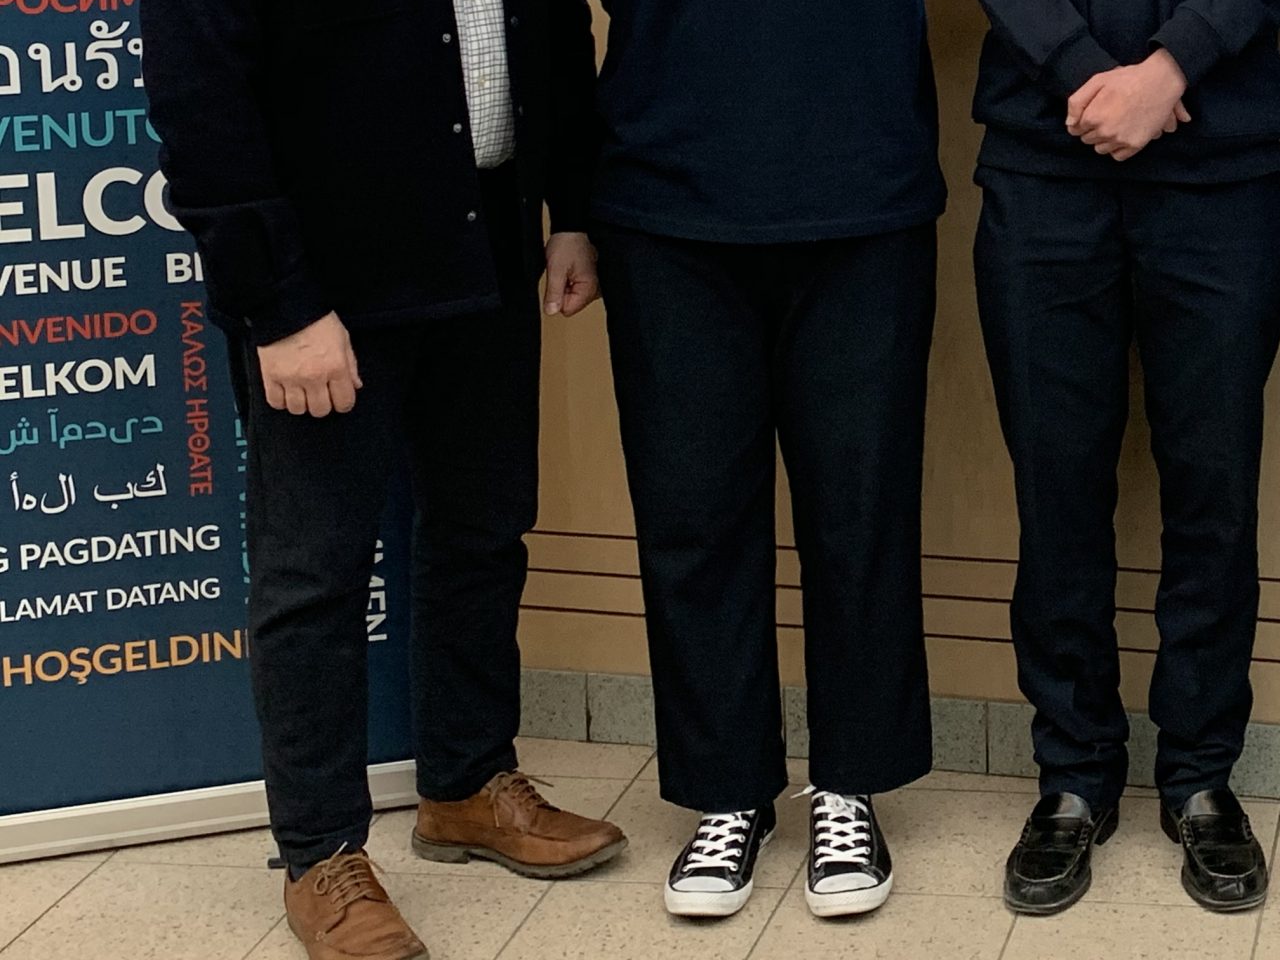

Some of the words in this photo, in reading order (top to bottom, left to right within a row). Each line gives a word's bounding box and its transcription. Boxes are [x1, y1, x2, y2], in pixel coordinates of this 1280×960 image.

[20, 524, 221, 572] PAGDATING
[0, 590, 99, 623] LAMAT
[106, 577, 221, 611] DATANG
[3, 628, 250, 688] HOŞGELDIN
